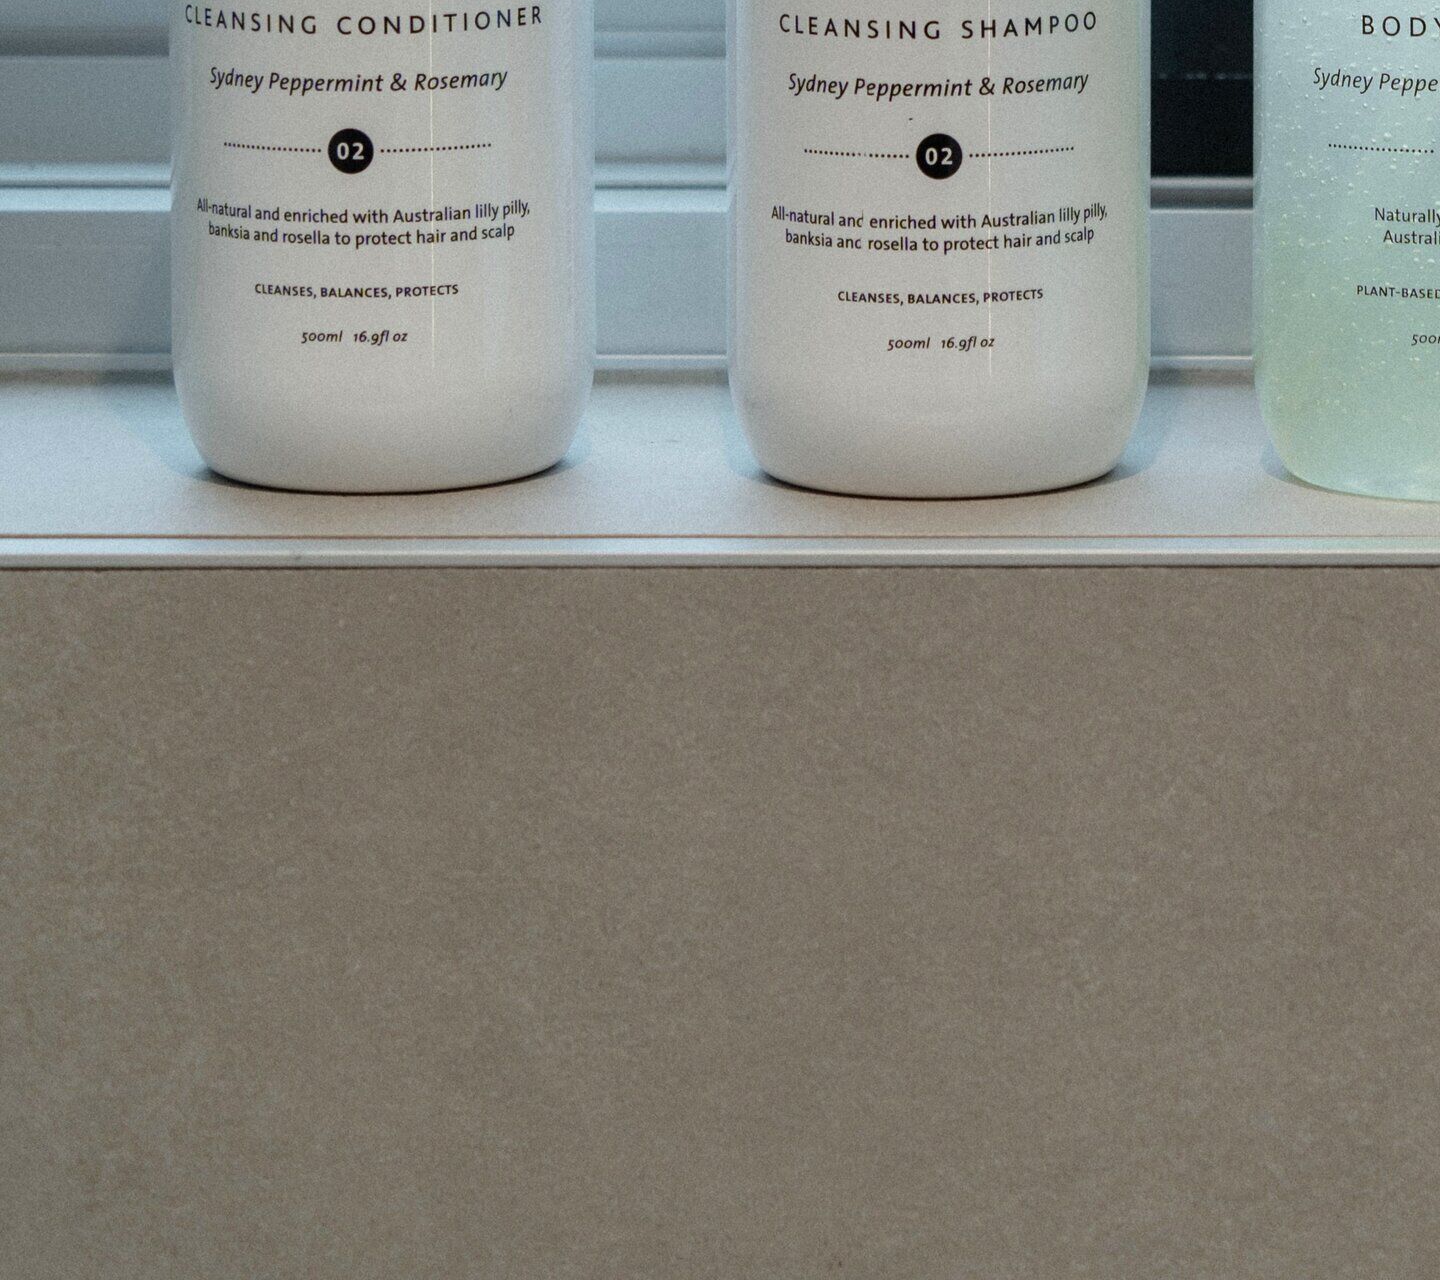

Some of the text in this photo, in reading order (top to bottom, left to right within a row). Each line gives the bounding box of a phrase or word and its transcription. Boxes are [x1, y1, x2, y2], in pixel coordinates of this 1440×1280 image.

[185, 4, 542, 35] CLEANSING CONDITIONER
[779, 11, 1097, 40] CLEANSING SHAMPOO
[209, 67, 509, 96] Sydney Peppermint & Rosemary
[788, 72, 1089, 102] Sydney Peppermint & Rosemary
[1313, 67, 1373, 95] Sydney
[336, 142, 365, 161] 02
[925, 147, 953, 166] 02
[196, 198, 531, 224] All-natural and enriched with Australian lilly pilly,
[771, 205, 835, 226] All-natural
[869, 215, 937, 230] enriched
[940, 214, 977, 229] with
[981, 211, 1056, 229] Australian
[1058, 207, 1081, 225] lilly
[1083, 203, 1108, 221] pilly,
[208, 224, 515, 249] banksia and rosella to protect hair and scalp
[785, 229, 834, 247] banksia
[867, 237, 918, 252] rosella
[922, 239, 940, 252] to
[943, 237, 1001, 255] protect
[1003, 233, 1033, 249] hair
[1035, 231, 1062, 246] and
[1064, 226, 1095, 244] scalp
[254, 283, 459, 300] CLEANSES, BALANCES, PROTECTS
[837, 288, 1044, 306] CLEANSES, BALANCES, PROTECTS
[301, 329, 343, 345] 500ml
[887, 336, 931, 352] 500ml
